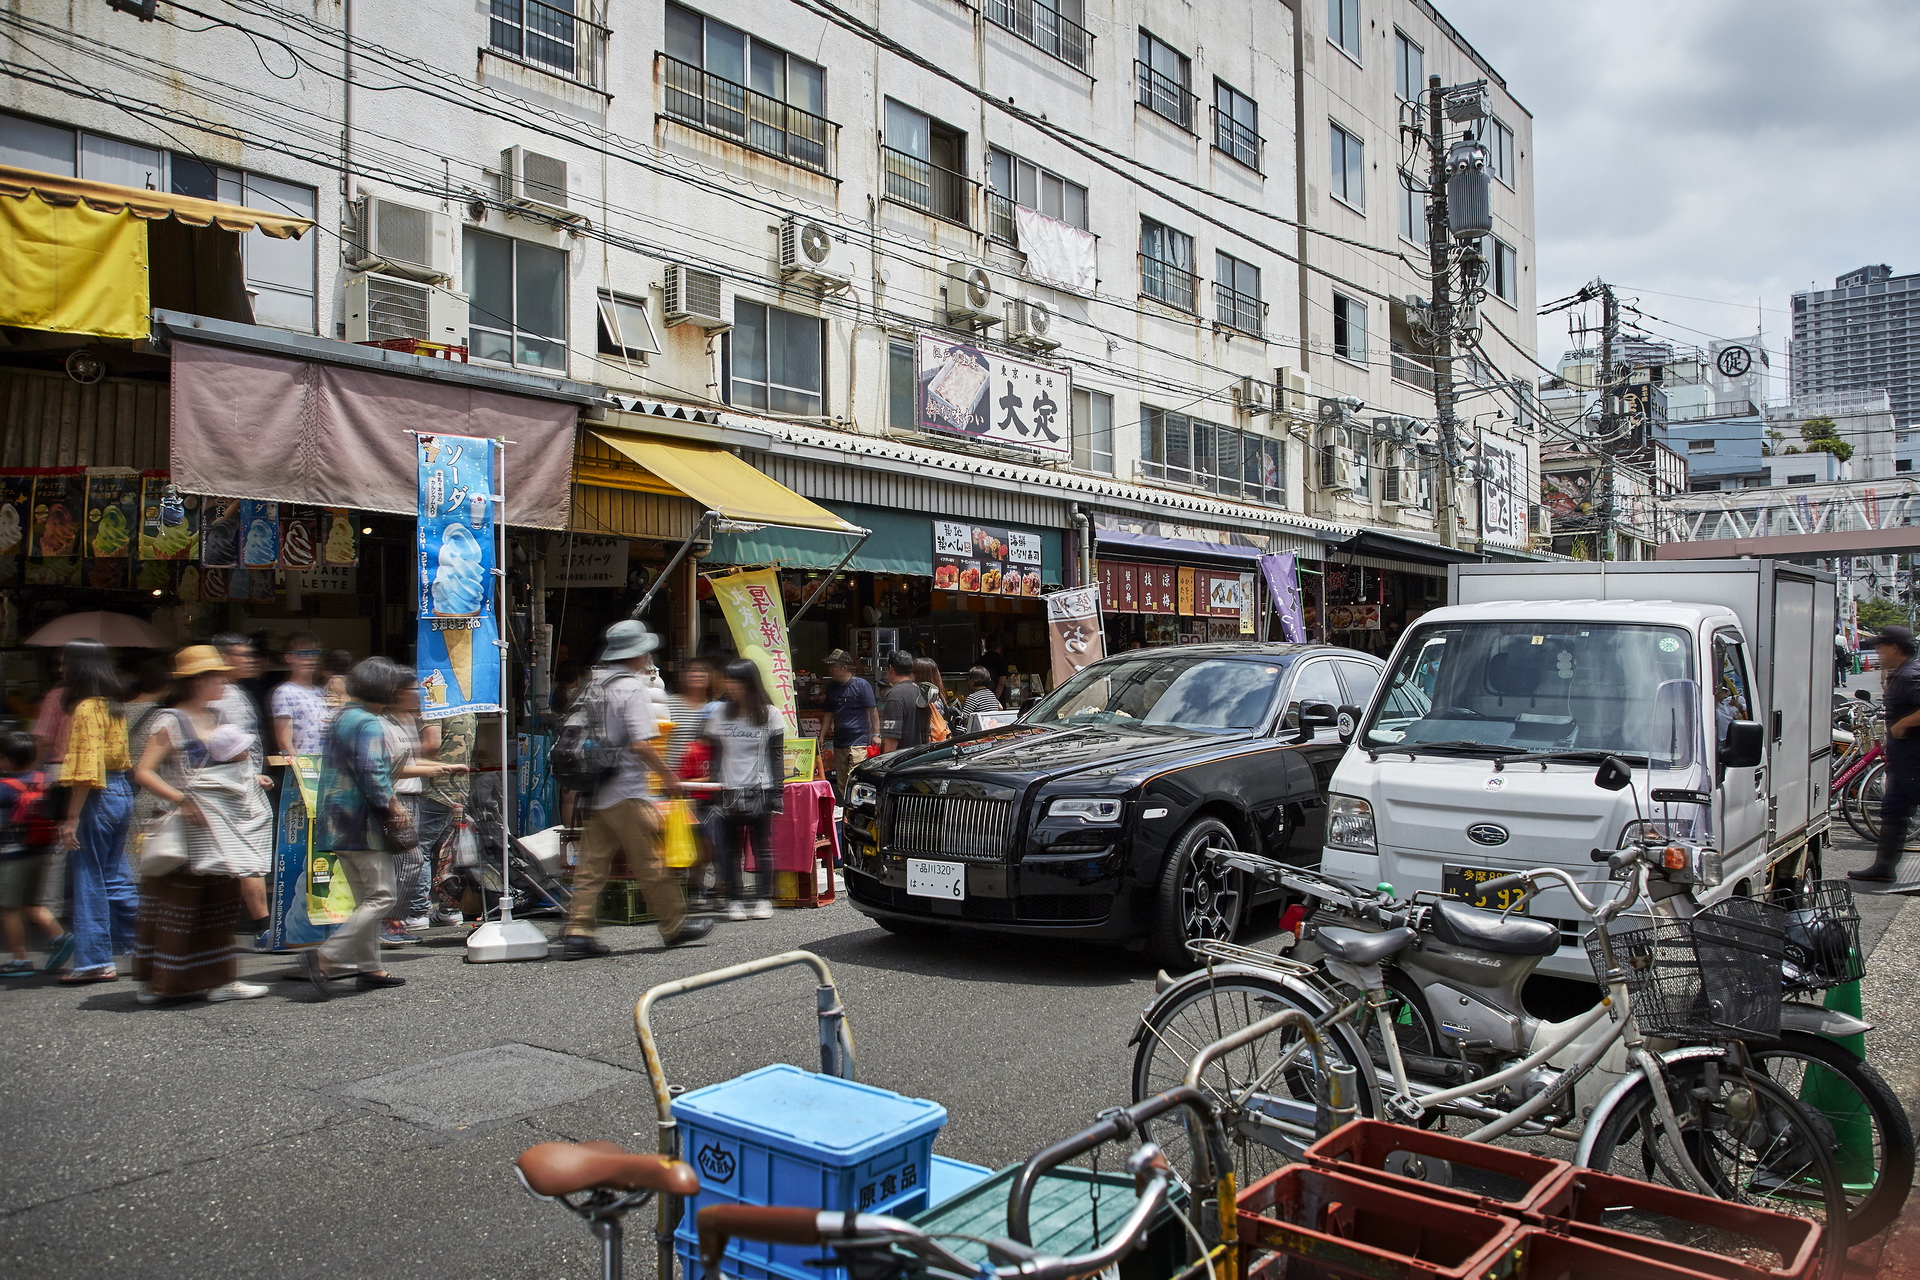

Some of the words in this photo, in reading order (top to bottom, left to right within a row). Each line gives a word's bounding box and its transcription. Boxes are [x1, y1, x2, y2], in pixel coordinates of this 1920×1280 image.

[997, 379, 1061, 443] 大定
[445, 444, 470, 513] ソーダ
[1144, 572, 1152, 606] 枝豆
[884, 720, 895, 729] 37
[1478, 957, 1501, 967] Cub
[701, 1155, 732, 1174] HARA
[859, 1164, 917, 1210] 原食品
